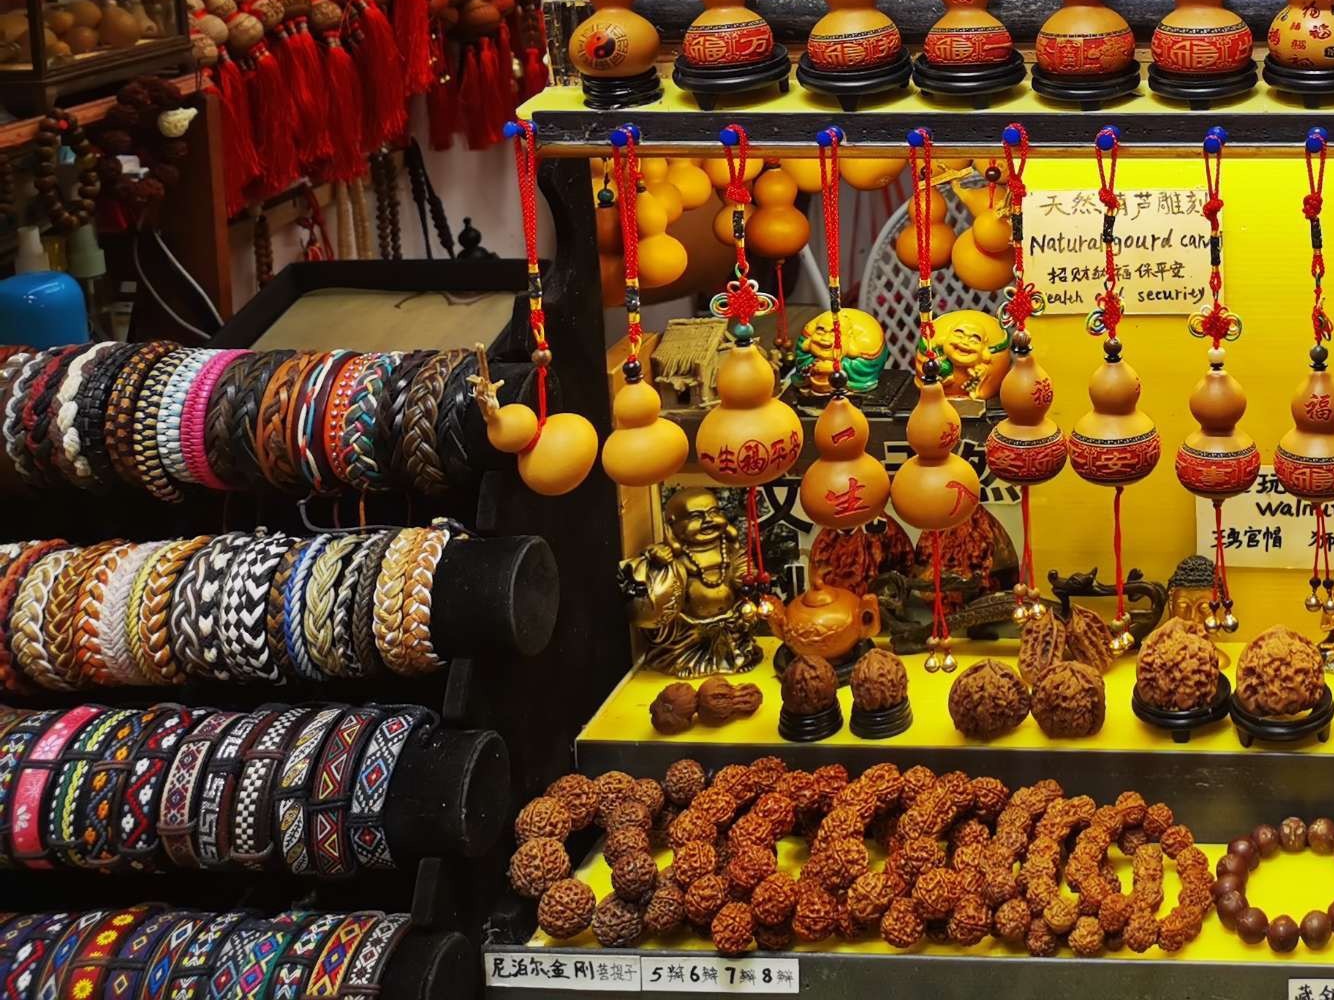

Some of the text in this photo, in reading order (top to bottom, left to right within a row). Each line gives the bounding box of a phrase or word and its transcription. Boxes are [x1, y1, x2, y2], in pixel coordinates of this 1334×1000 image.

[1044, 289, 1084, 305] ealth
[1137, 286, 1206, 305] security
[1033, 378, 1054, 405] 福
[1304, 393, 1333, 421] 福
